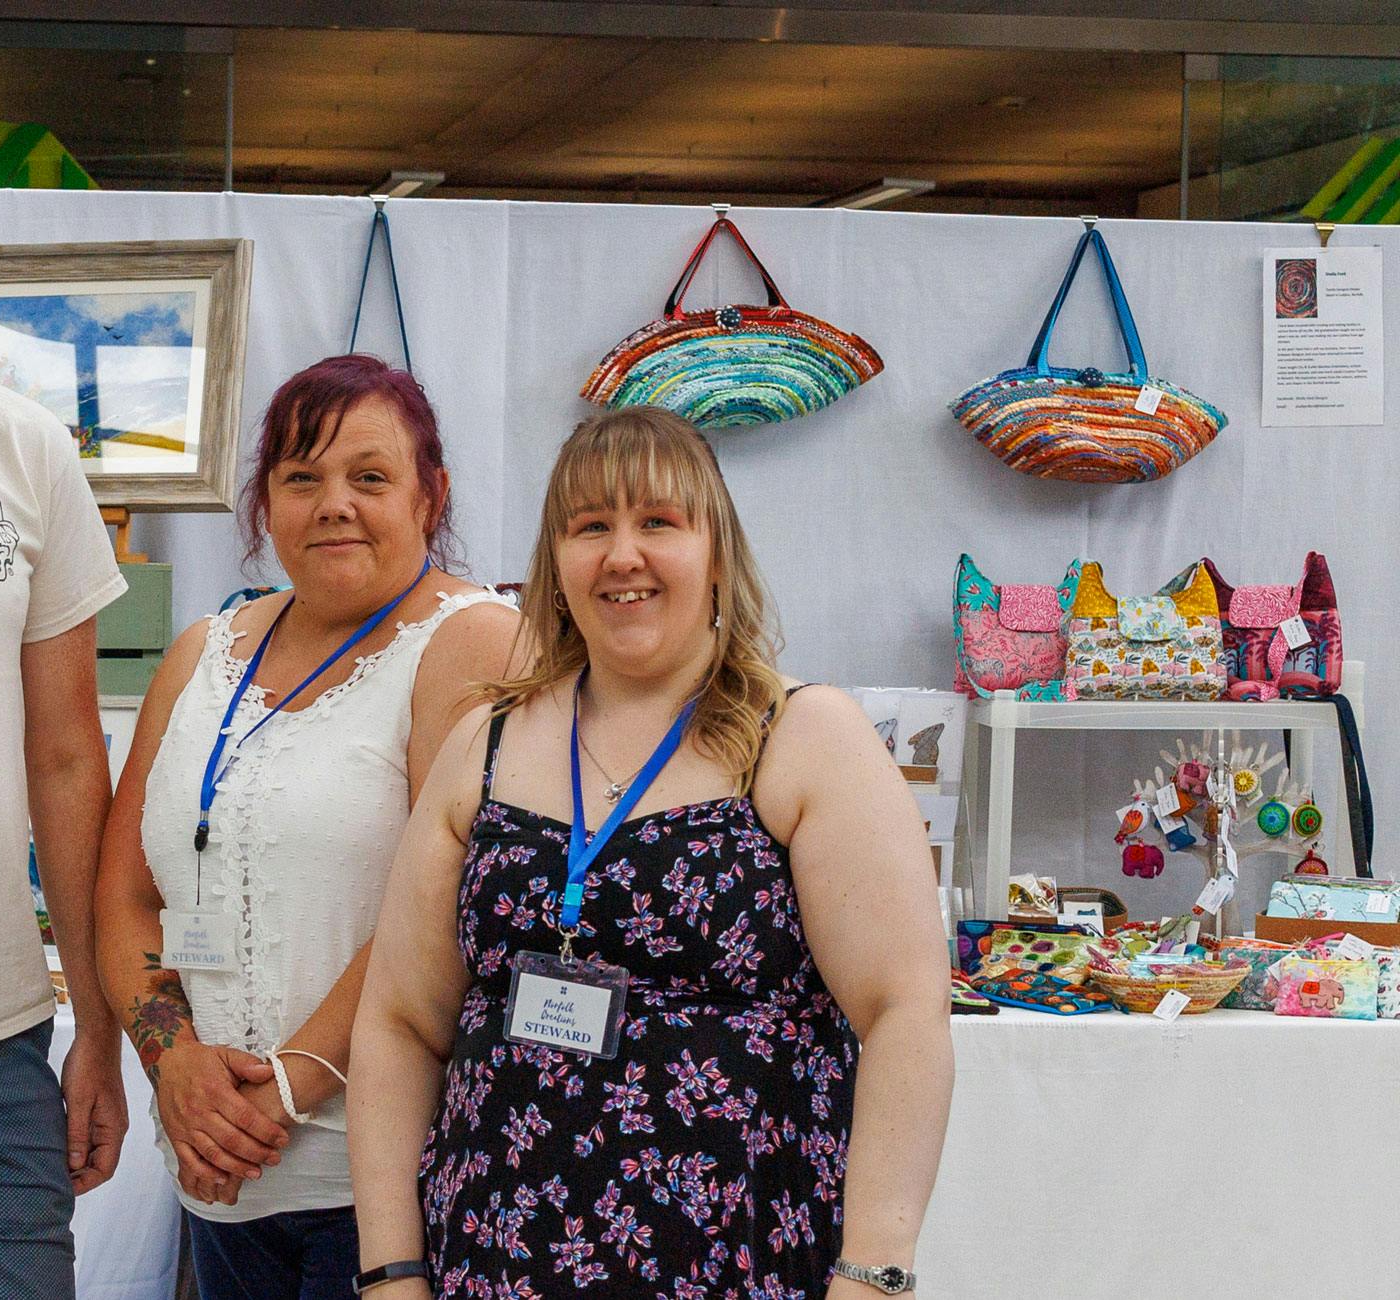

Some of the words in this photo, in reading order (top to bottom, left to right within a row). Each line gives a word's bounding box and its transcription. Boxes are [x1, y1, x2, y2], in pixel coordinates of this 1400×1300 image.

[171, 952, 225, 963] STEWARD
[543, 999, 574, 1013] Norfolk
[524, 1021, 591, 1044] STEWARD
